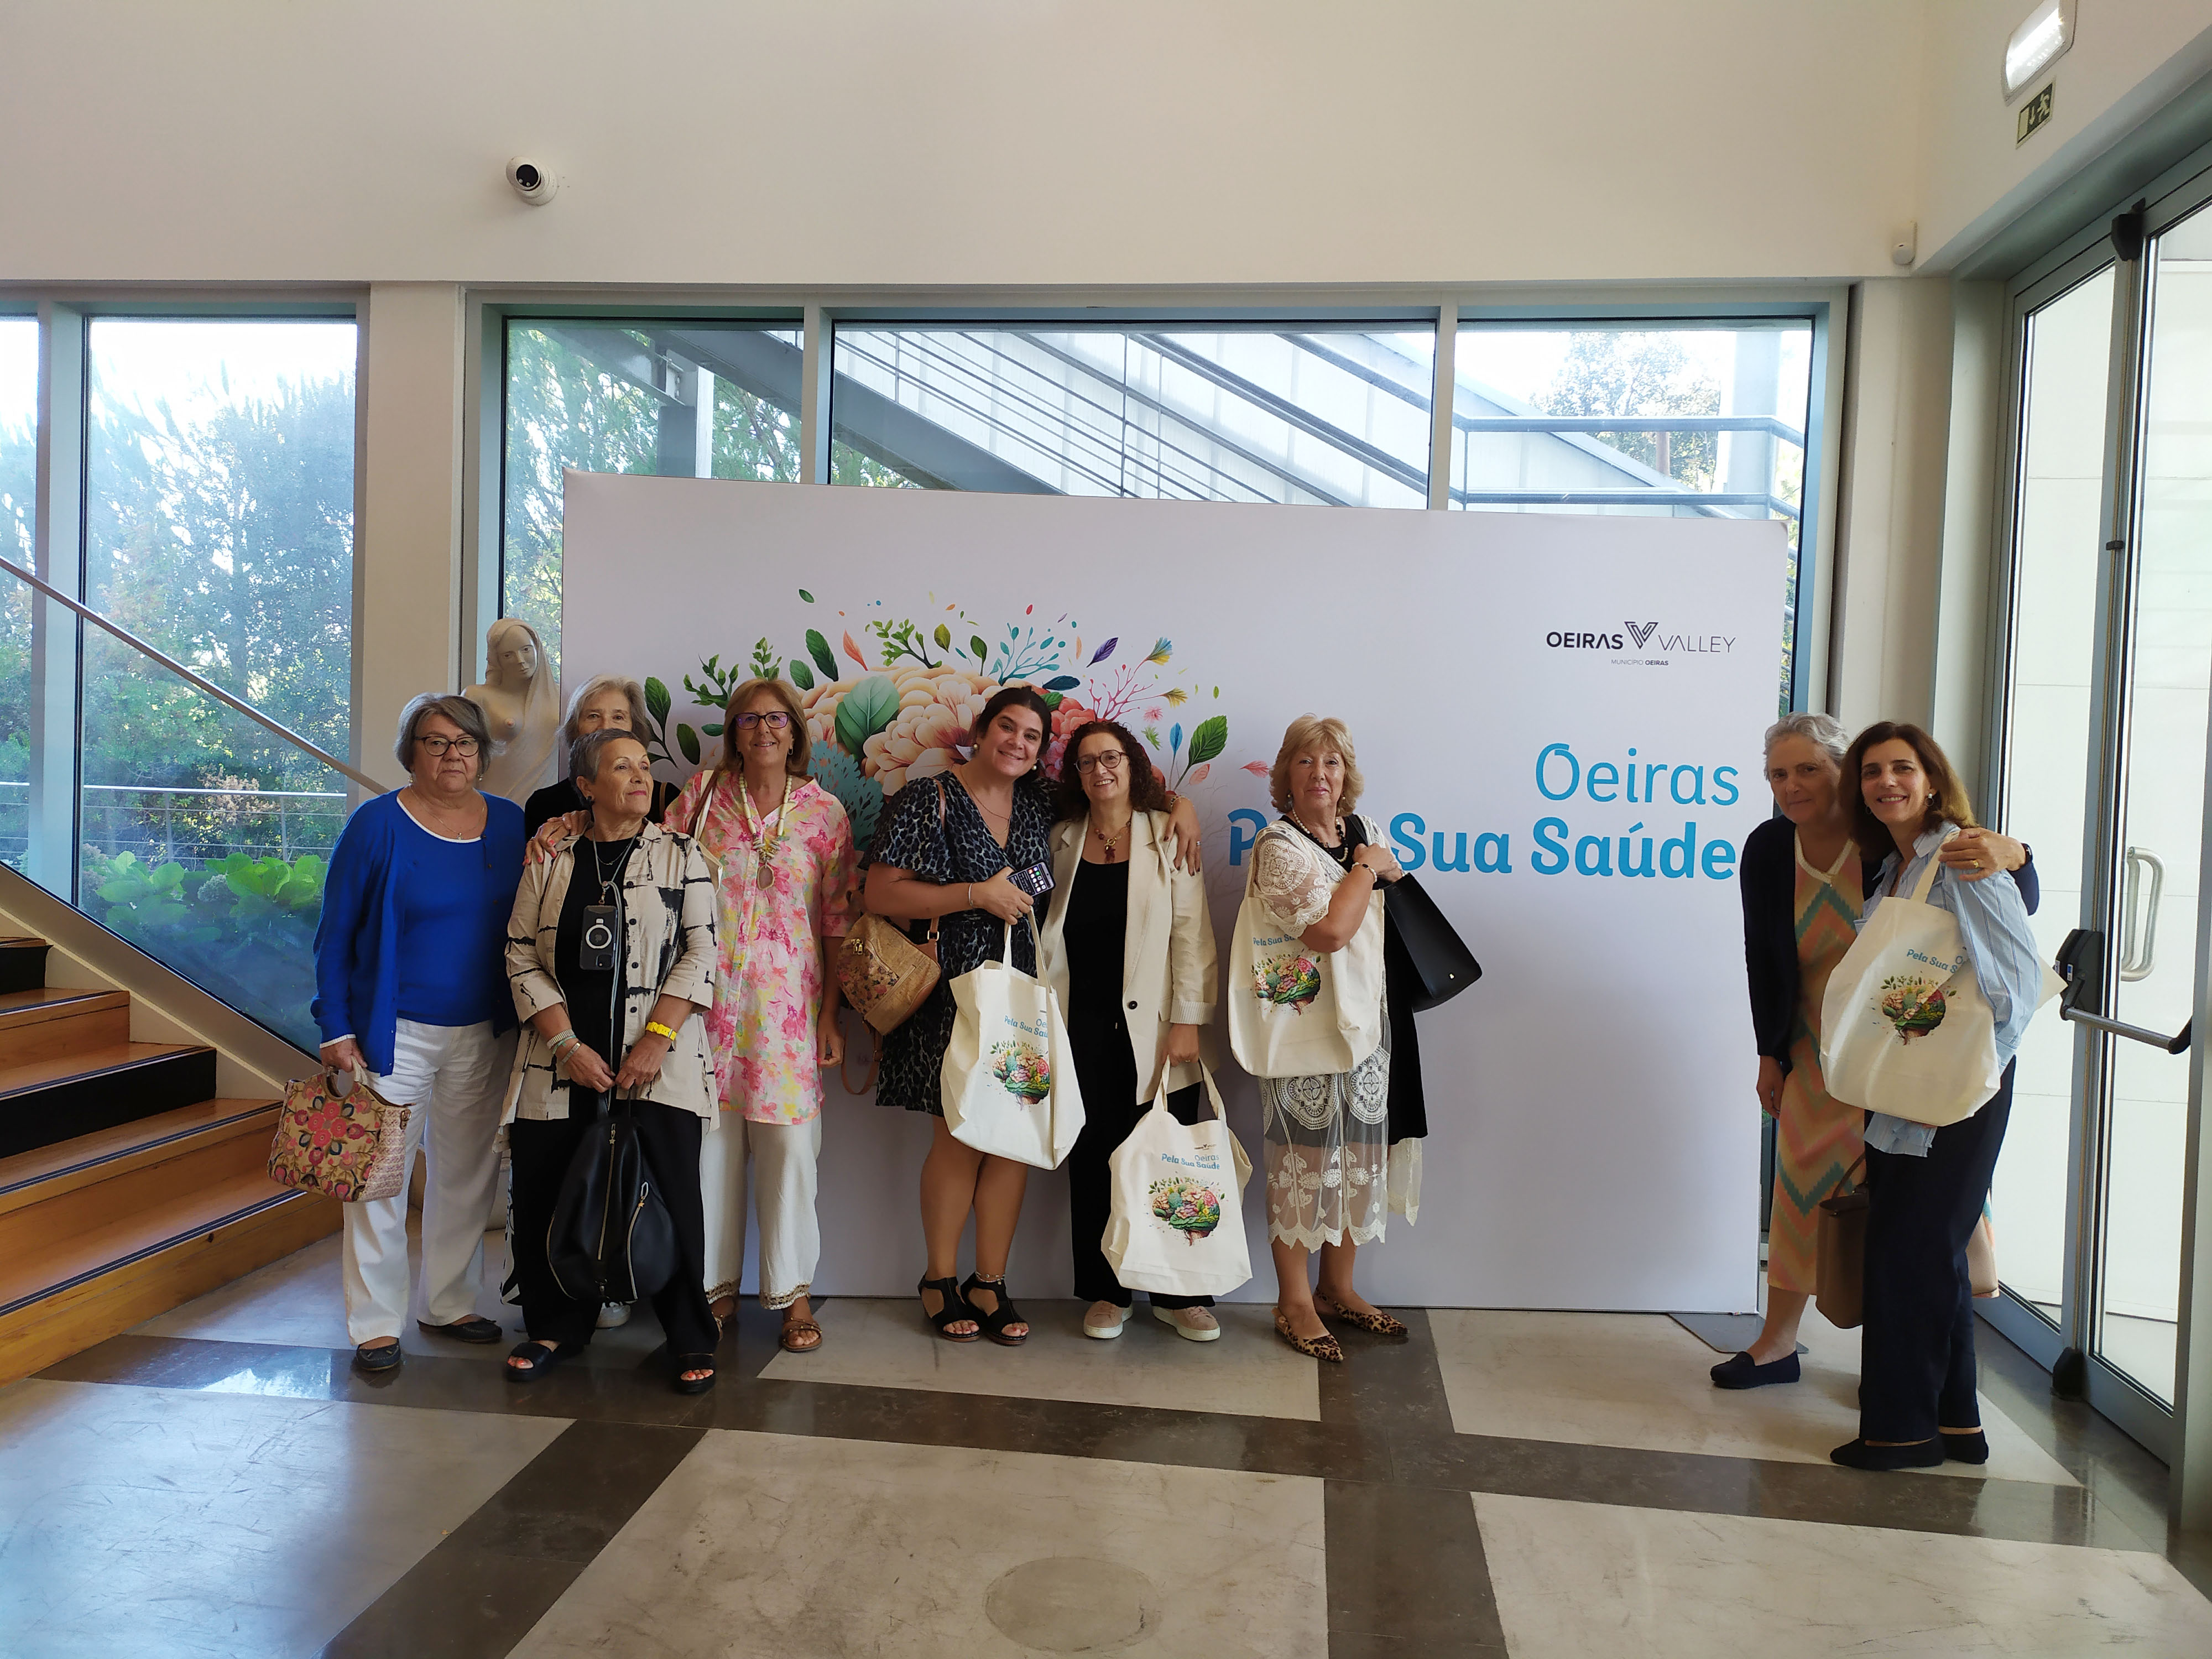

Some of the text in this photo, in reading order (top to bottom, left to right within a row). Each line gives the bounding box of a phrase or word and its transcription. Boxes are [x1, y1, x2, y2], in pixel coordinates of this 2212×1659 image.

[1546, 632, 1736, 653] OEIRAS VALLEY
[1536, 743, 1739, 806] Oeiras
[1389, 812, 1736, 880] Sua Saúde
[1253, 937, 1266, 946] Pela
[1267, 937, 1282, 946] Sua
[1907, 949, 1928, 963] Pela
[1929, 957, 1948, 971] Sua
[1004, 1015, 1018, 1027] Pela
[1019, 1021, 1032, 1033] Sua
[1161, 1153, 1220, 1170] Pela Sua Saúde
